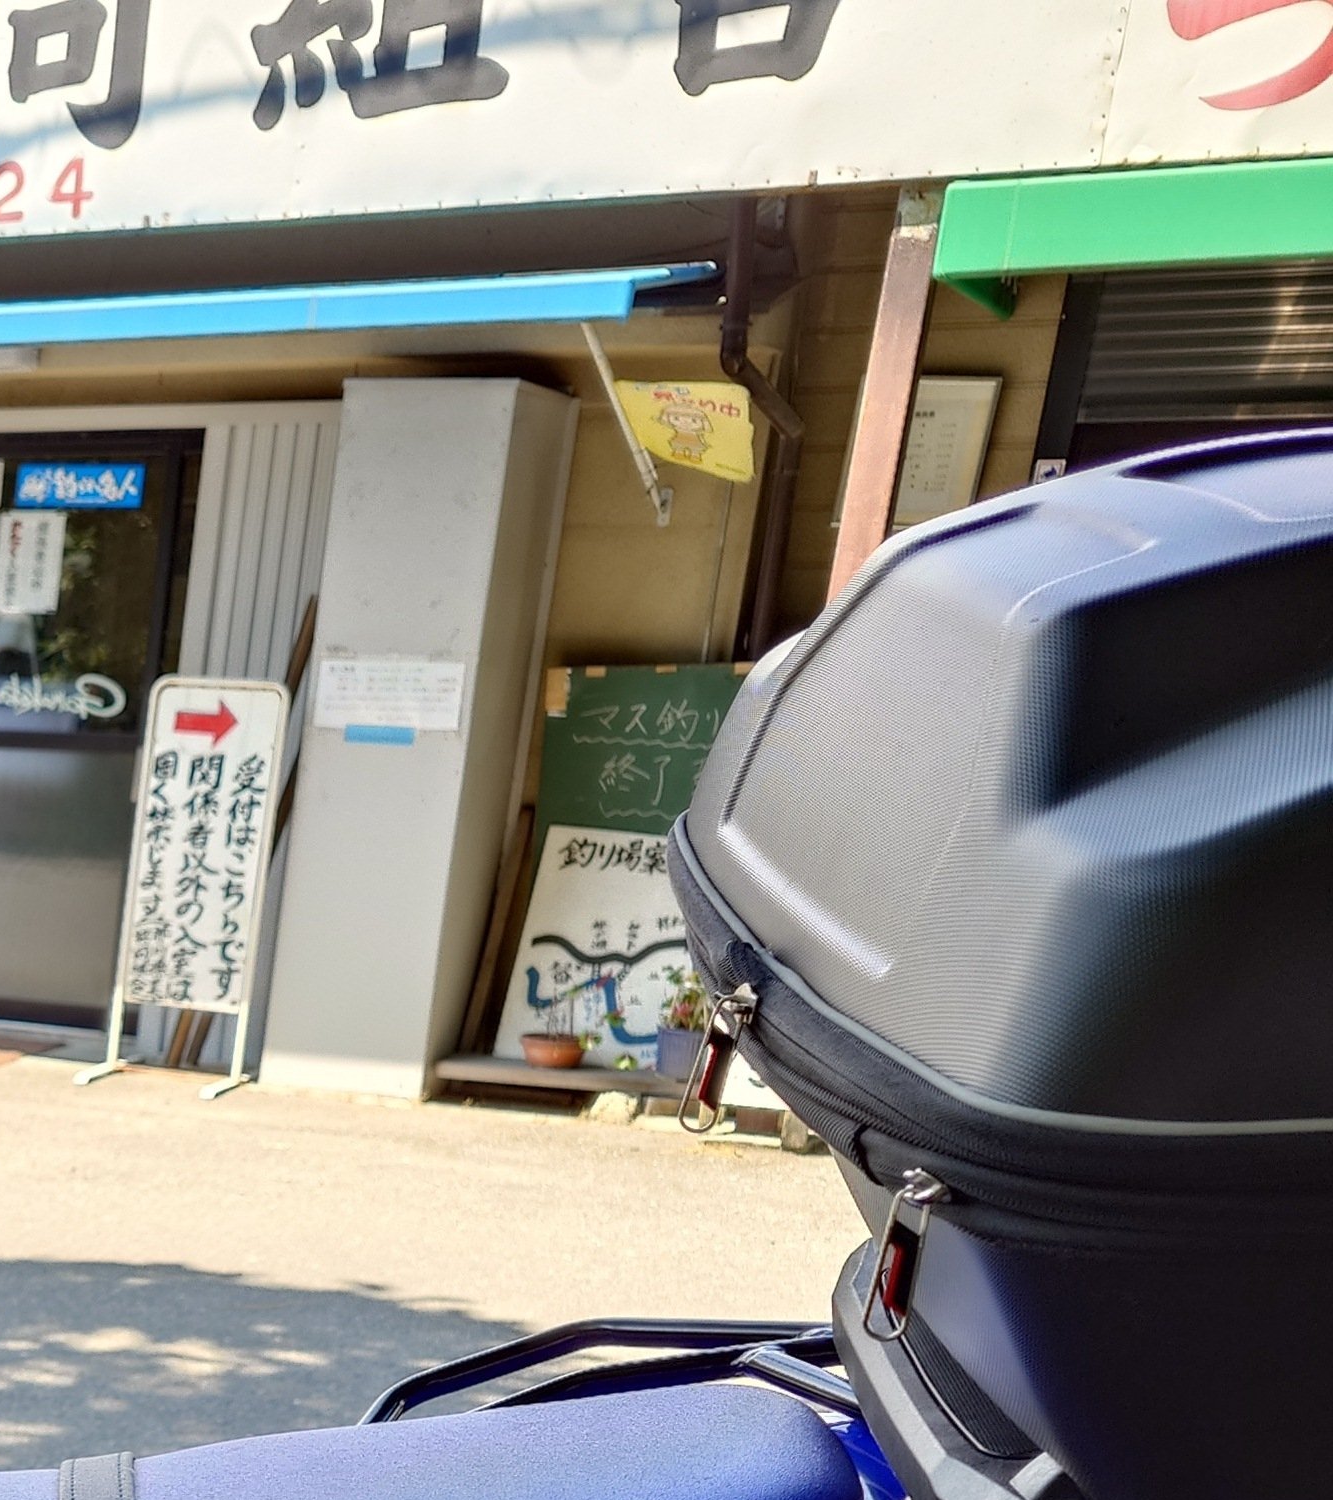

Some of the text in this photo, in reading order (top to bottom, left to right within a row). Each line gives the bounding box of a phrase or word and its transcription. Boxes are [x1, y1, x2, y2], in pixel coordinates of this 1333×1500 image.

[208, 752, 267, 1001] 受付はこちらです
